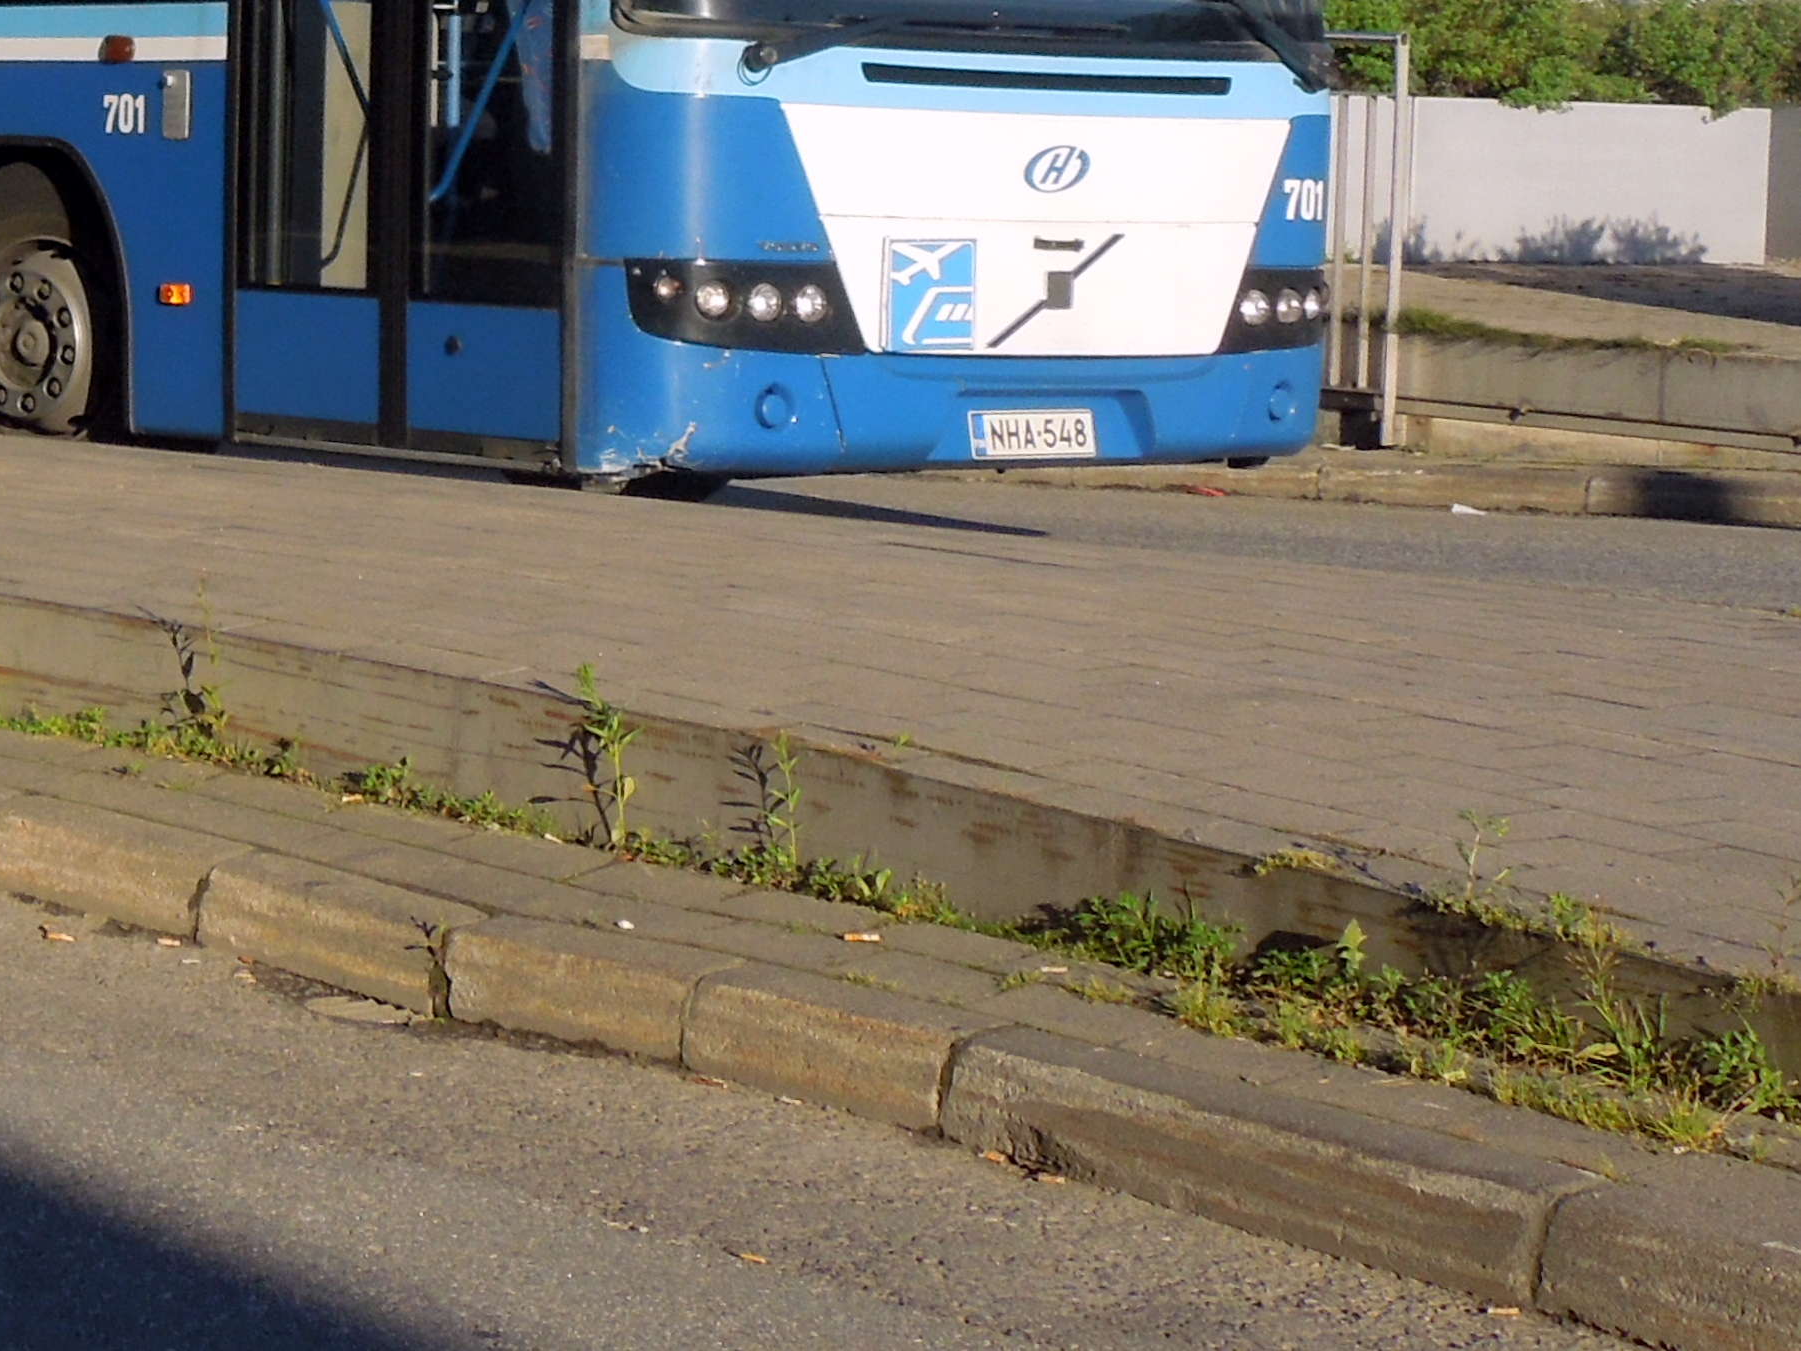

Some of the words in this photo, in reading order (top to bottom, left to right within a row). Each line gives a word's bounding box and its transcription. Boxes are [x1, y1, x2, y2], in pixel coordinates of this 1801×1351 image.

[103, 93, 146, 134] 701
[1283, 179, 1324, 221] 701
[987, 417, 1087, 450] NHA-548
